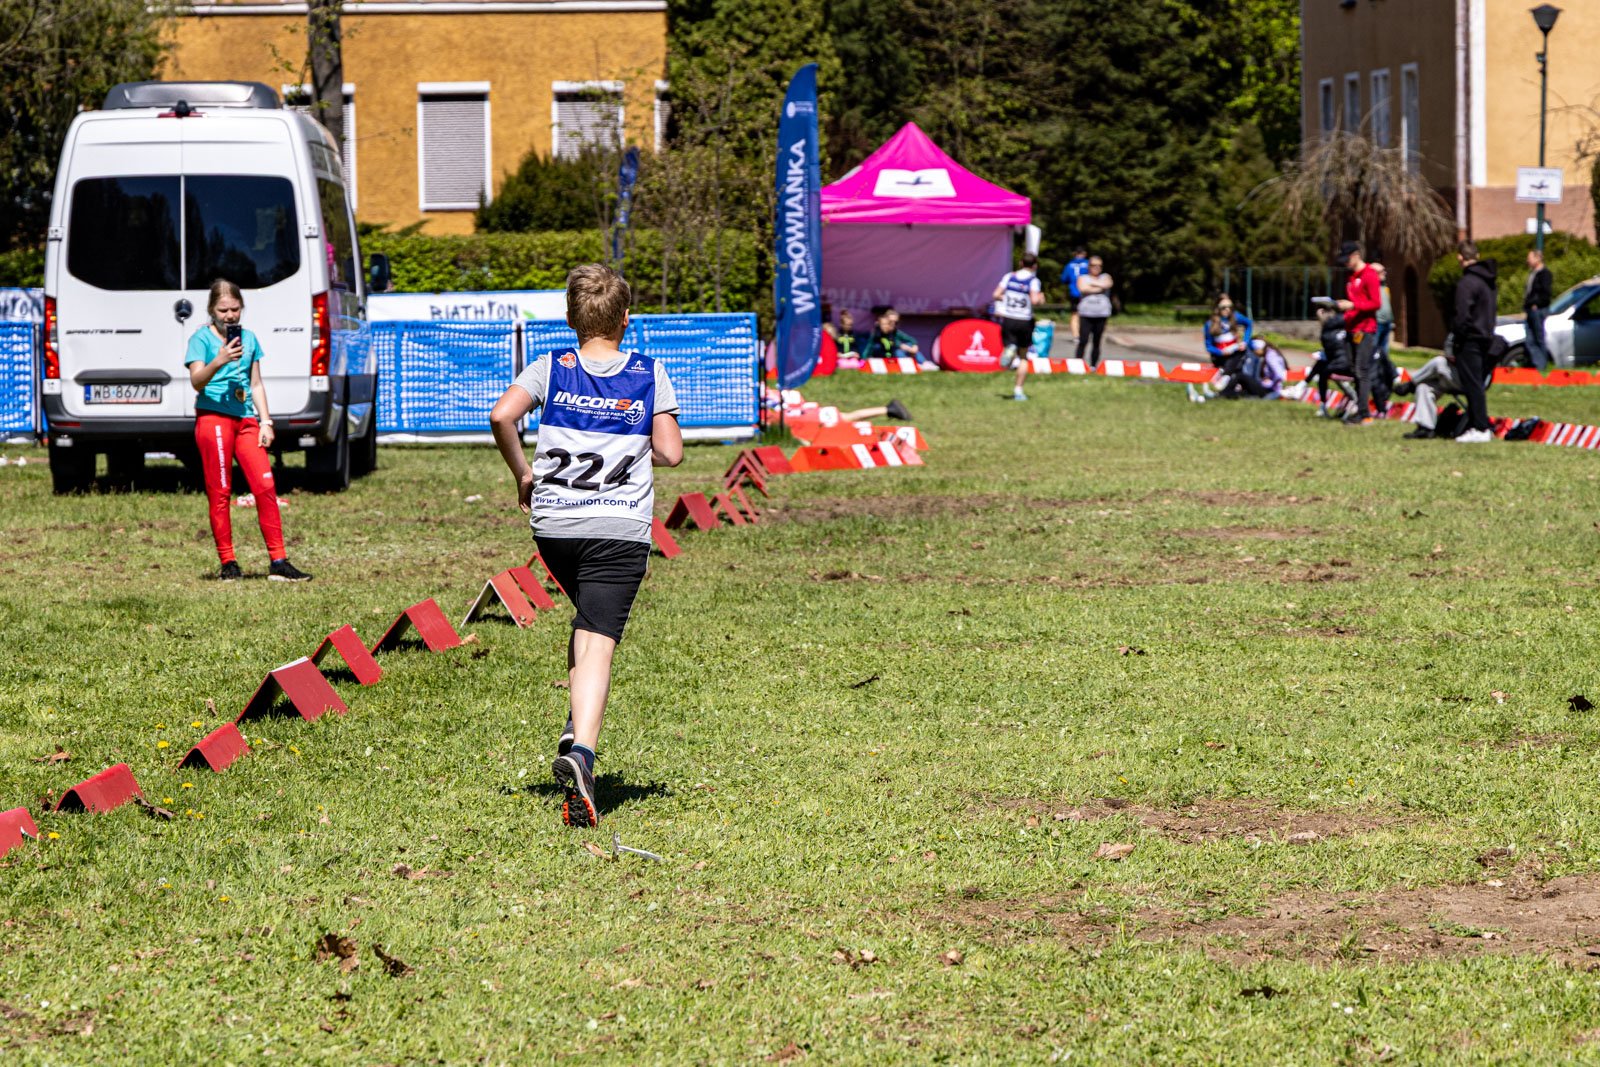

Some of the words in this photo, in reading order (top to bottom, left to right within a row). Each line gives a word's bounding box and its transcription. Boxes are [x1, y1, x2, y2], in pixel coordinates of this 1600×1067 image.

[785, 138, 816, 315] WYSOWIANKA
[93, 383, 111, 399] WB
[116, 383, 158, 399] 8677W
[553, 391, 644, 411] INCORSA
[541, 448, 635, 491] 224
